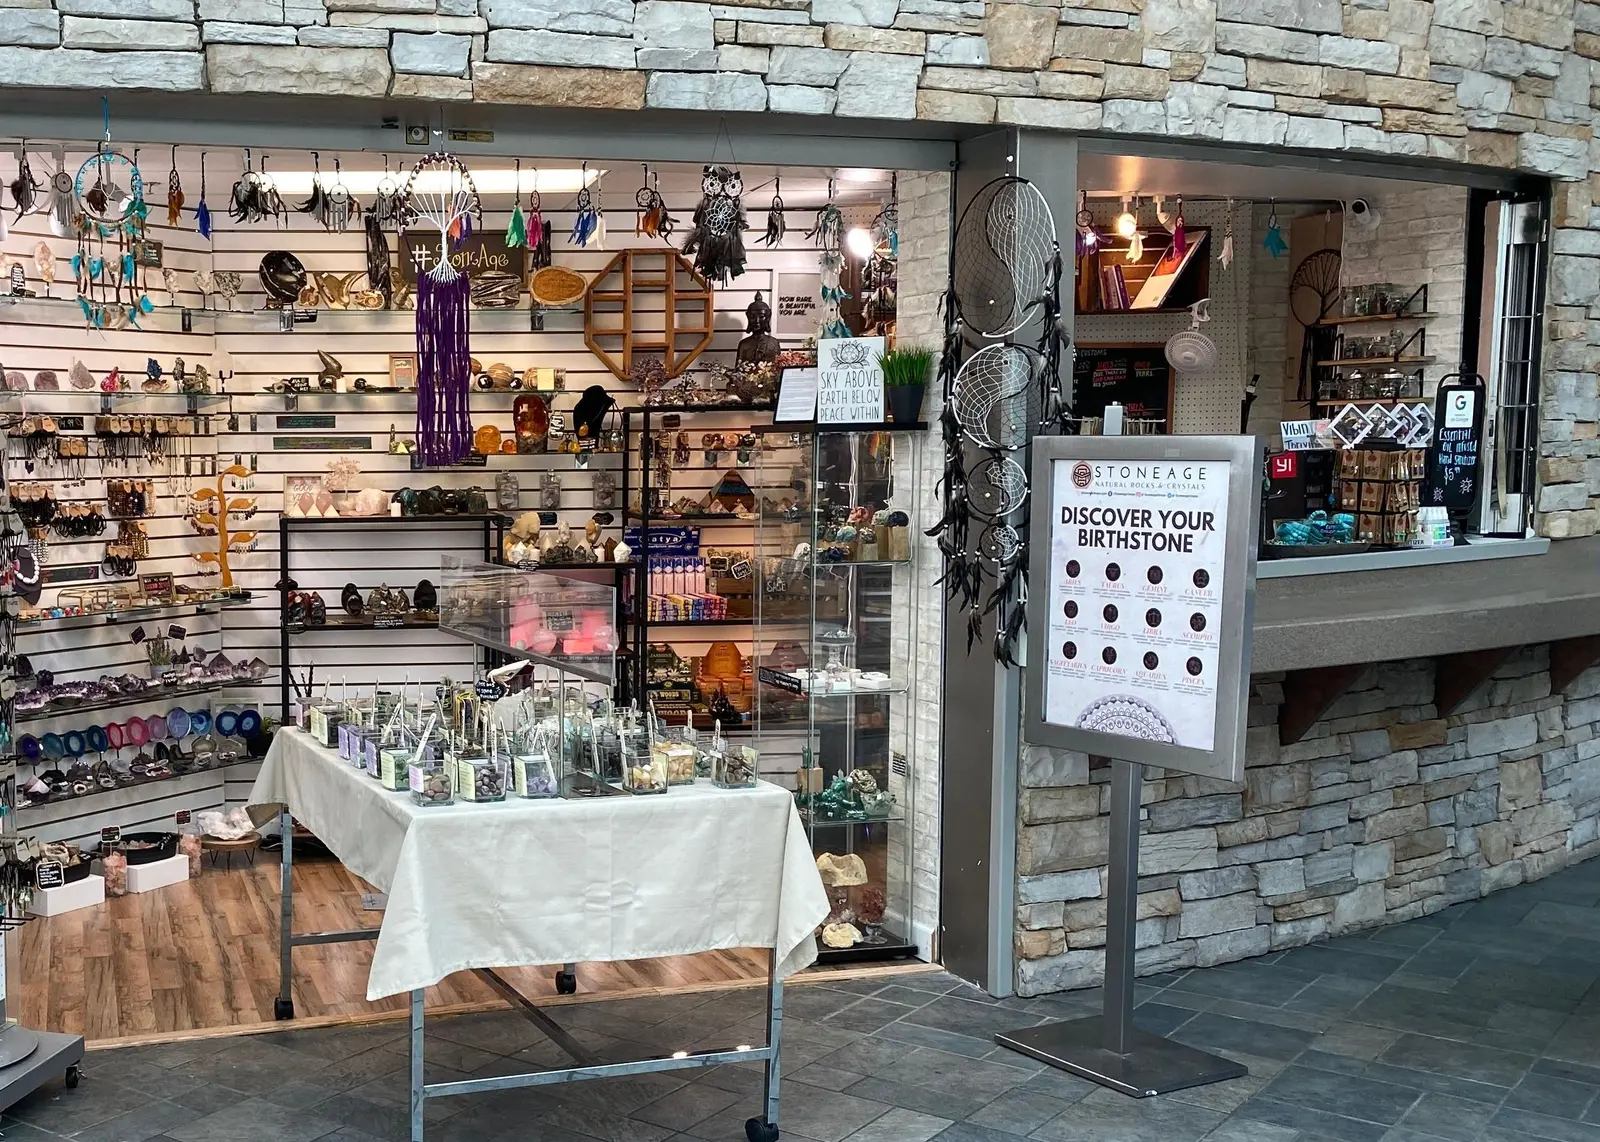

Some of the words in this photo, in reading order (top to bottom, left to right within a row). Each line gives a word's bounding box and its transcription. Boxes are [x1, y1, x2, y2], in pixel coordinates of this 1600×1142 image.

[821, 372, 839, 389] SKY
[845, 369, 880, 388] ABOVE
[820, 390, 848, 405] EARTH
[852, 389, 881, 404] BELOW
[820, 407, 845, 421] PEACE
[850, 406, 880, 420] WITHIN
[1440, 427, 1471, 442] Essential
[1095, 466, 1207, 480] STONEAGE
[1276, 458, 1292, 473] YI
[1061, 506, 1153, 528] DISCOVER
[1158, 509, 1216, 532] YOUR
[648, 534, 680, 543] atya
[1078, 528, 1194, 553] BIRTHSTONE
[1182, 632, 1213, 641] SCORPIO
[1091, 665, 1127, 675] CAPRICORN
[1181, 677, 1205, 686] PISCES
